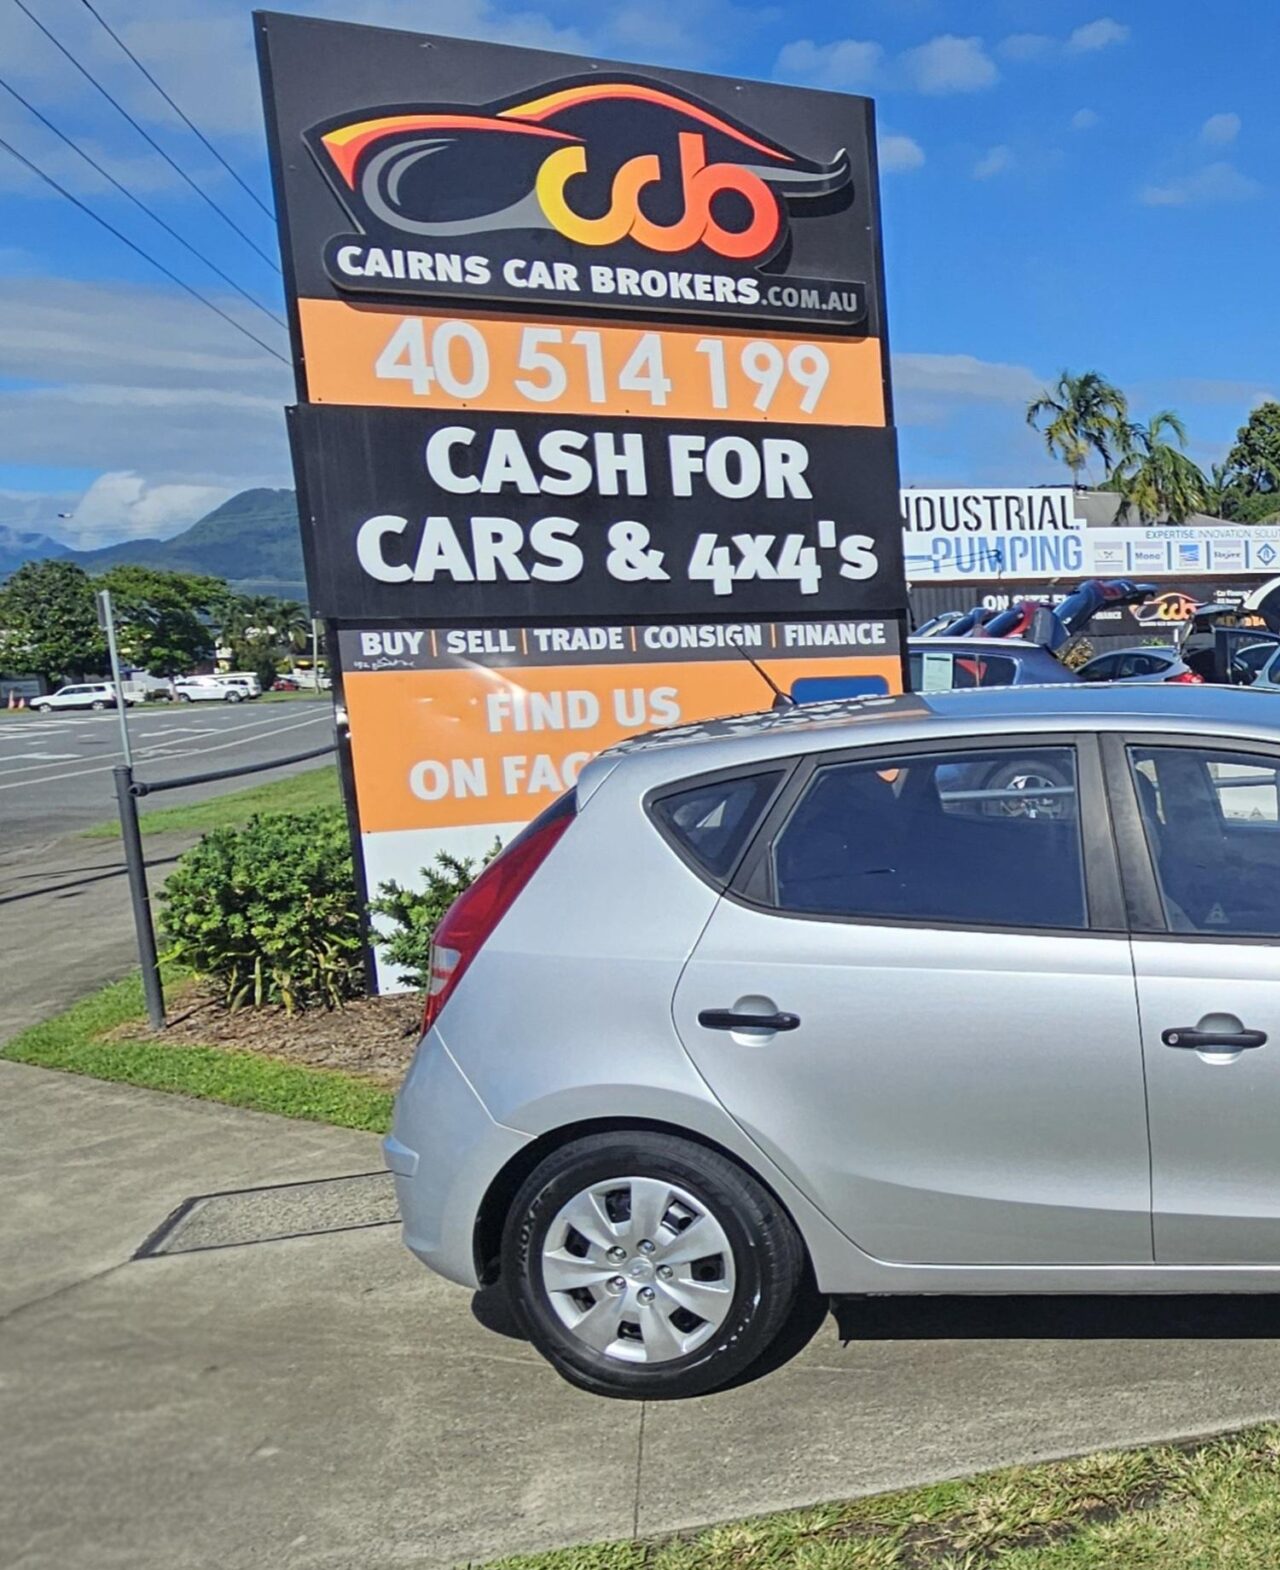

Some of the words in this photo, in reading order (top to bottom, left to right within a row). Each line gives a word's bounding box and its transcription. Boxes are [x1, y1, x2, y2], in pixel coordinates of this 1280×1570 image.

[336, 245, 491, 285] CAIRNS
[502, 258, 581, 292] CAR
[375, 315, 490, 399] 40
[514, 326, 673, 406] 514
[696, 338, 830, 414] 199
[425, 427, 648, 496] CASH
[668, 434, 813, 500] FOR
[356, 514, 584, 583] CARS
[606, 520, 671, 582] &
[1145, 530, 1195, 540] EXPERTISE
[1199, 529, 1251, 538] INNOVATION
[931, 535, 1083, 573] PUMPING
[360, 630, 424, 656] BUY
[446, 629, 516, 655] SELL
[533, 627, 625, 651] TRADE
[643, 624, 762, 649] CONSIGN
[784, 623, 886, 647] FINANCE
[486, 689, 600, 733] FIND
[613, 687, 681, 728] US
[409, 758, 488, 801] ON
